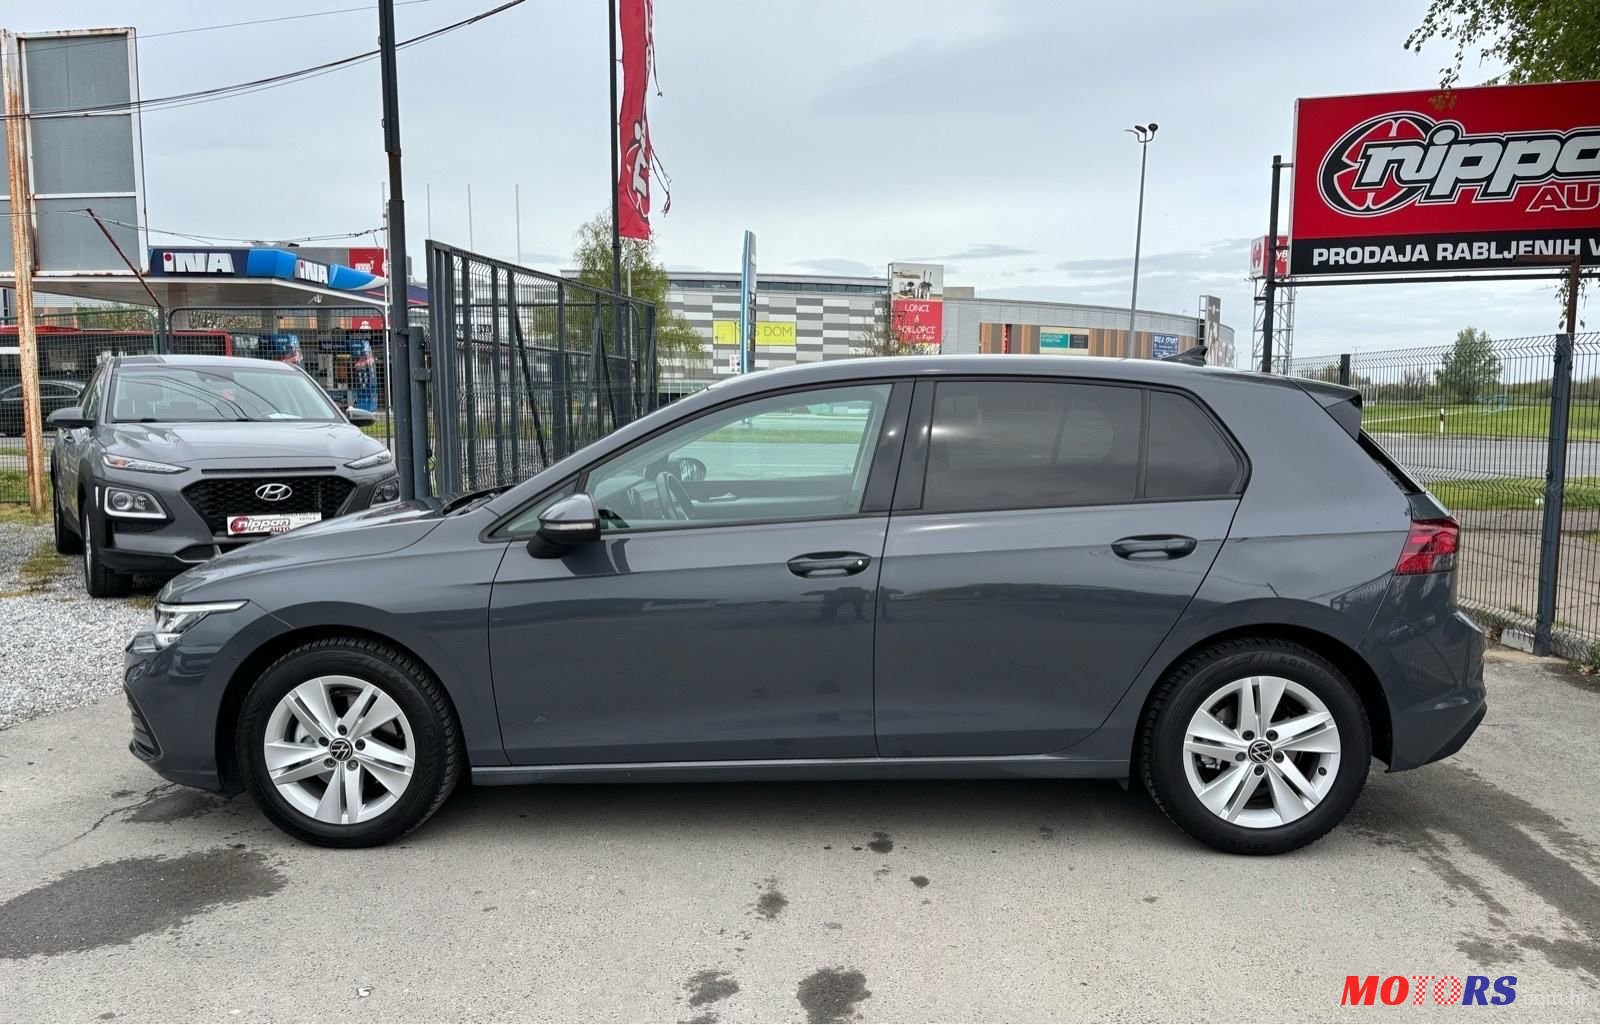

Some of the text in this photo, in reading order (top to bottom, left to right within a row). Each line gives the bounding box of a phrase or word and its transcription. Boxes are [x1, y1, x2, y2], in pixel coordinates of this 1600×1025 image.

[1312, 243, 1429, 266] PRODAJA
[1436, 238, 1581, 262] RABLJENIH
[904, 303, 930, 313] LONCI
[763, 326, 793, 337] DOM
